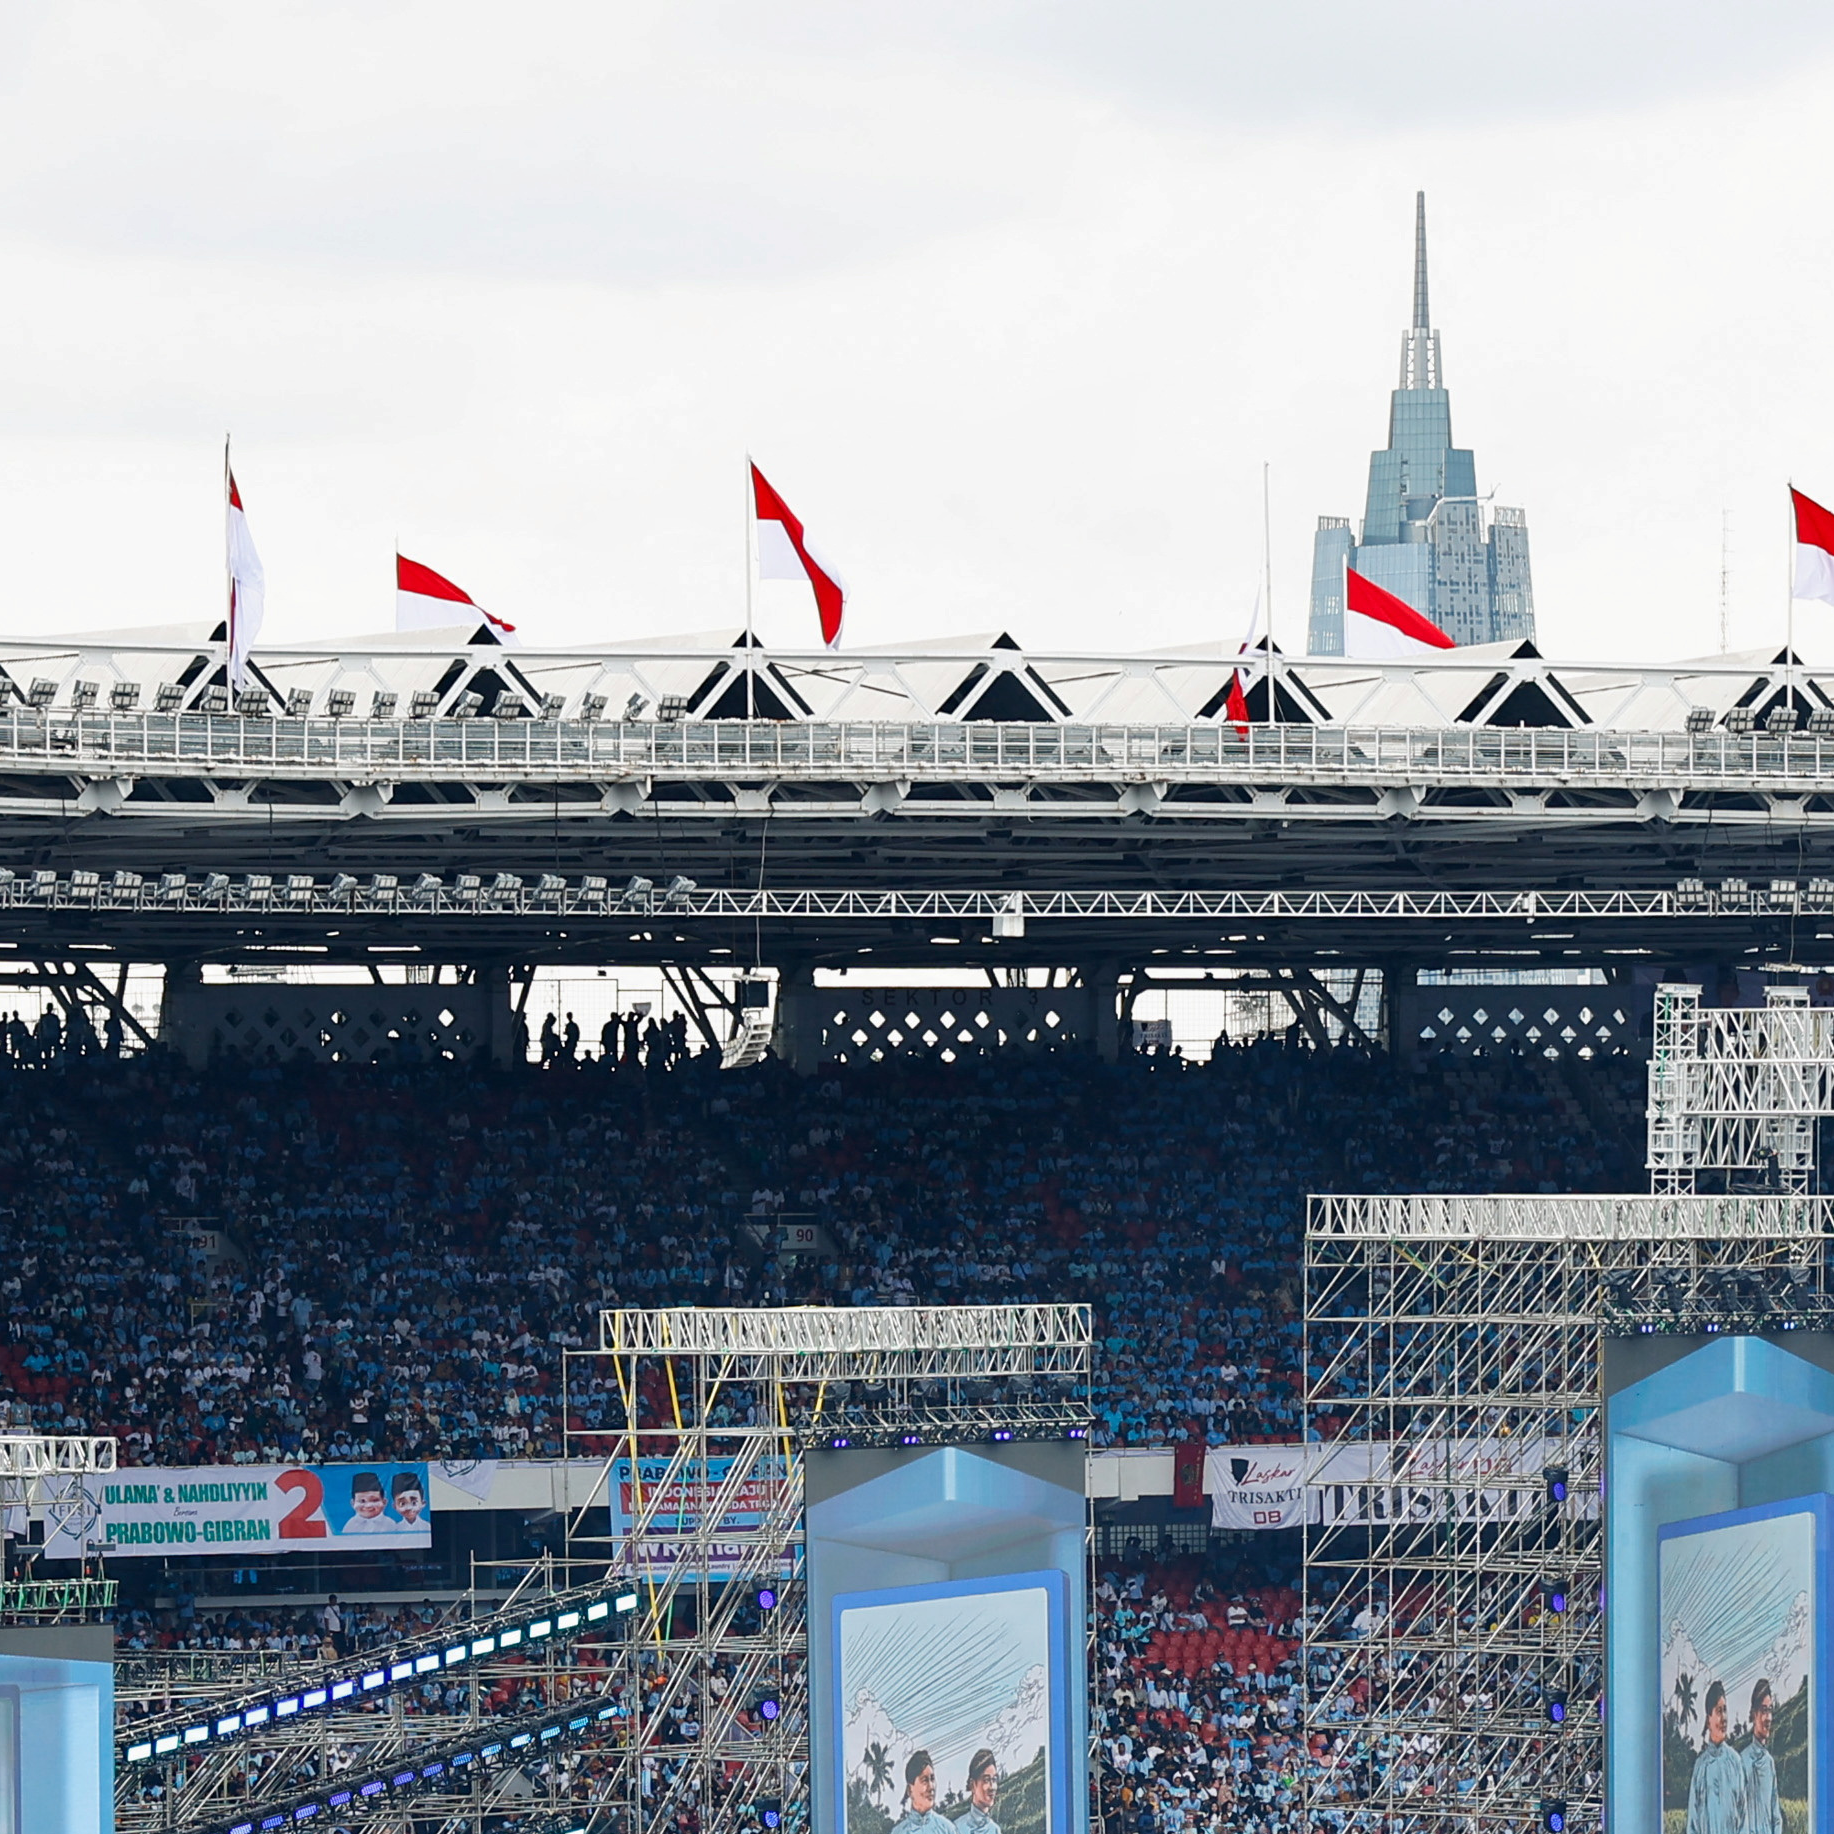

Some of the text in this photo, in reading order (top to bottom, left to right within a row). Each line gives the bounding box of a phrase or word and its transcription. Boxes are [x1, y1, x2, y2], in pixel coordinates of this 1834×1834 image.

[862, 989, 993, 1006] SEKTOR
[200, 1235, 216, 1249] 91
[796, 1228, 813, 1242] 90
[163, 1486, 173, 1503] &
[178, 1481, 269, 1503] NAHDLIYYIN
[1228, 1487, 1302, 1504] TRISAKTI
[274, 1468, 327, 1539] 2
[106, 1519, 271, 1545] PRABOWO-GIBRAN
